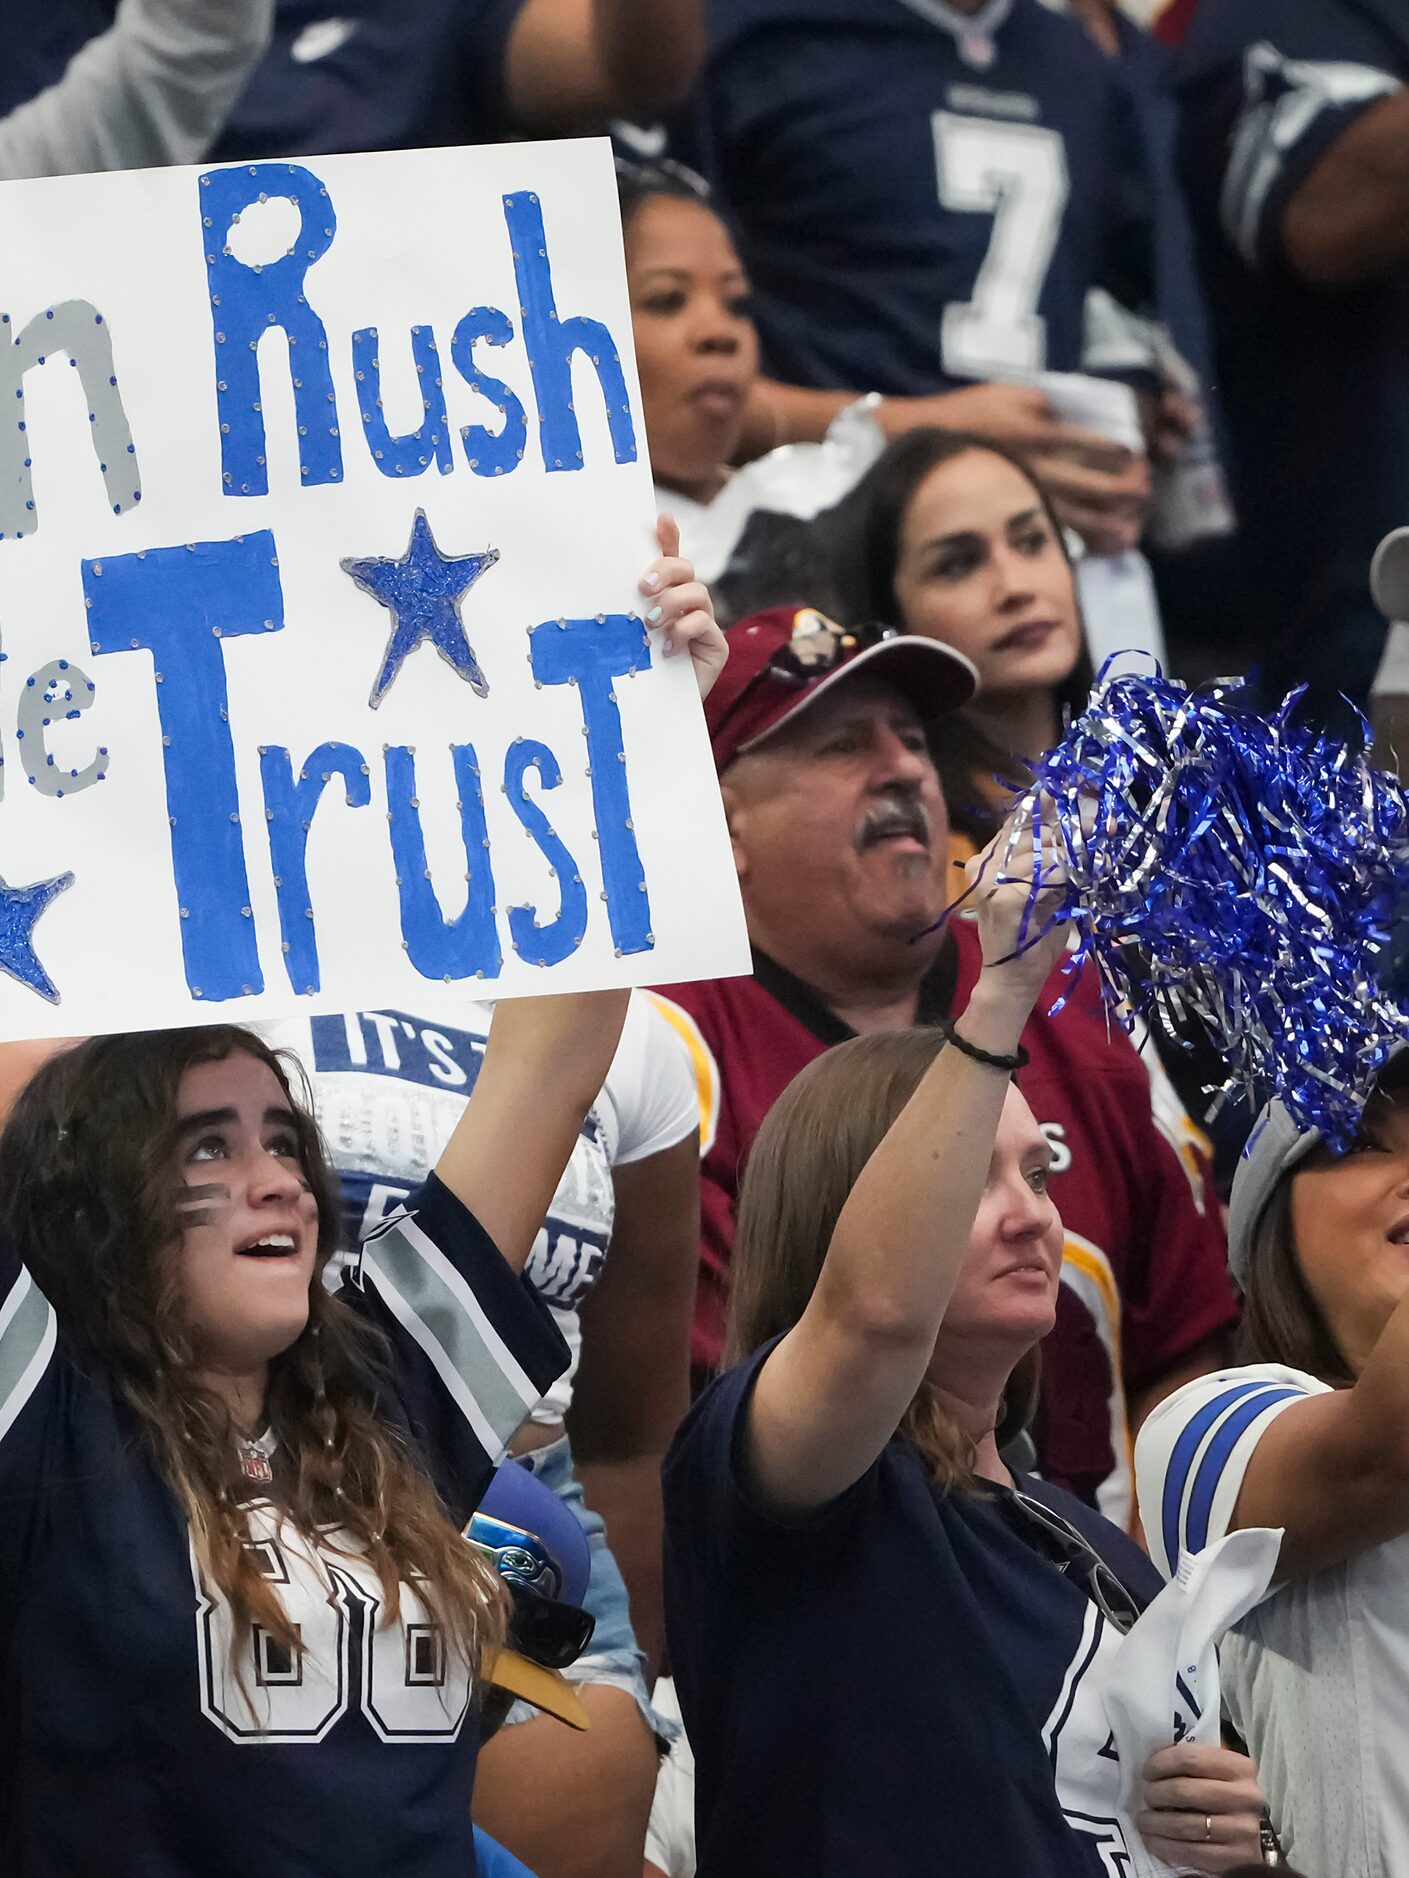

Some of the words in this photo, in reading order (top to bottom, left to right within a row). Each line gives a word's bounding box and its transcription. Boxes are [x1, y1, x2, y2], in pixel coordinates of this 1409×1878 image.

[198, 162, 638, 497] Rush
[931, 110, 1070, 378] 7
[342, 1010, 468, 1086] IT'S
